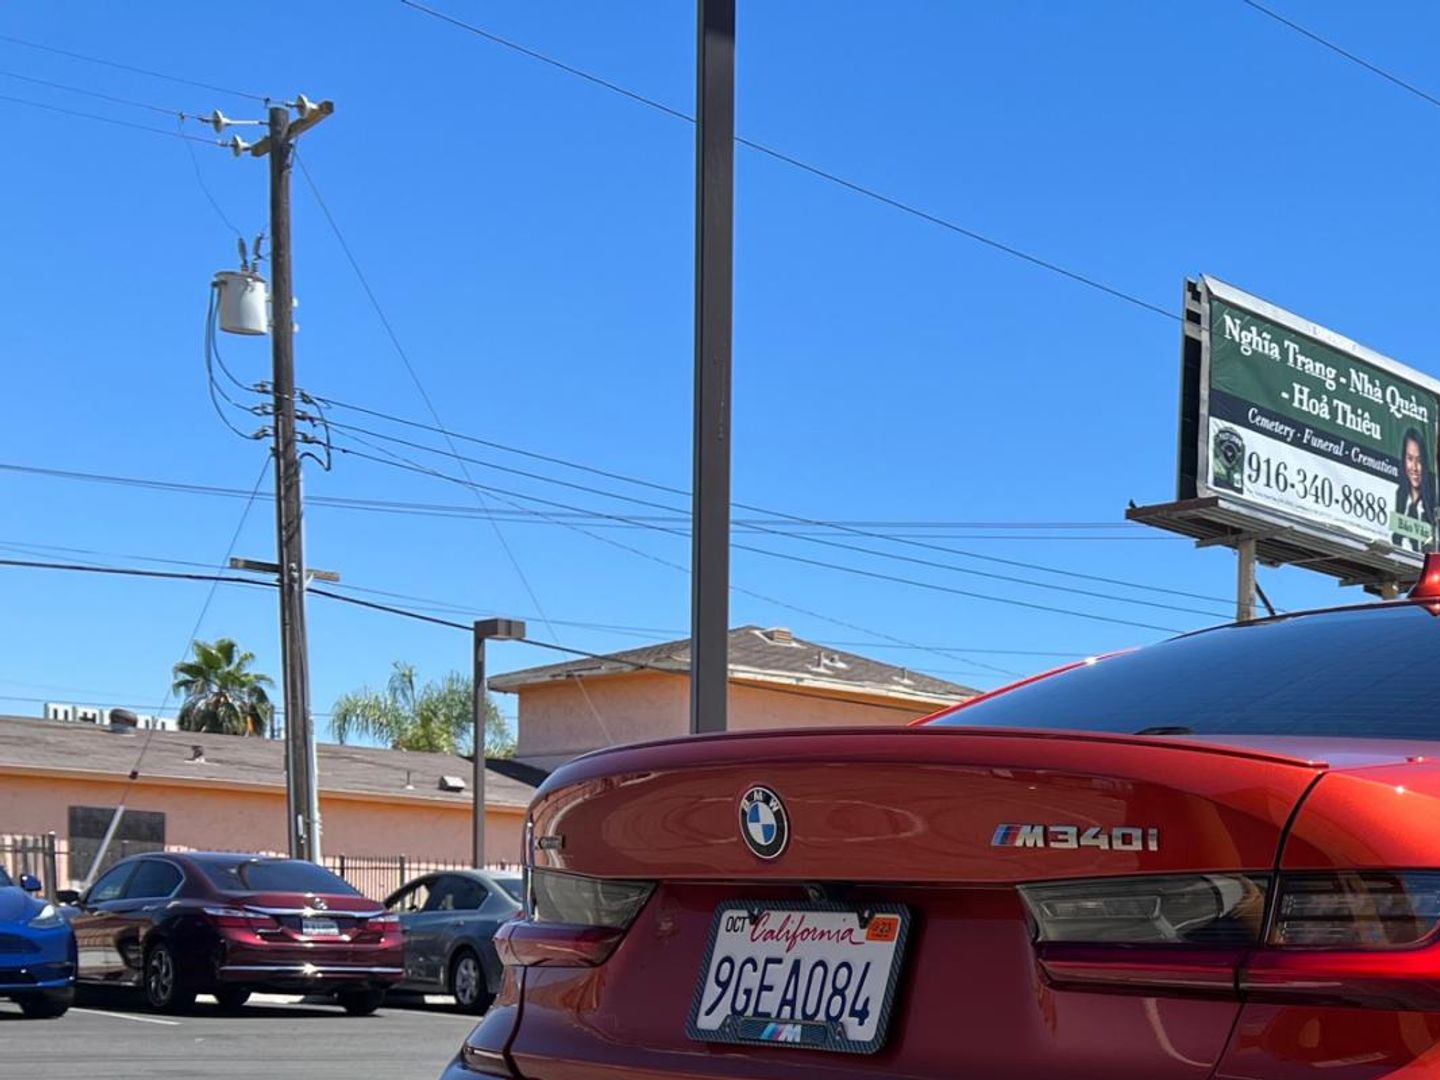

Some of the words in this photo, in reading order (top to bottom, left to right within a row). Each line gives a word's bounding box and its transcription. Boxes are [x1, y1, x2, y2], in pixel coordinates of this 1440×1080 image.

[1223, 315, 1281, 361] Nghĩa
[1284, 340, 1337, 391] Trang
[1349, 368, 1385, 404] Nhà
[1386, 386, 1430, 422] Quàn
[1333, 399, 1382, 440] Thiêu
[1248, 407, 1297, 442] Cemetery
[1303, 428, 1345, 457] Funeral
[1351, 447, 1399, 477] Cremation
[1247, 451, 1388, 526] 916-340-8888
[741, 790, 779, 812] BMW
[1016, 825, 1158, 851] M340i
[725, 915, 749, 932] OCT
[750, 911, 865, 952] California
[704, 954, 872, 1027] 9GEA084
[778, 1023, 802, 1042] M
